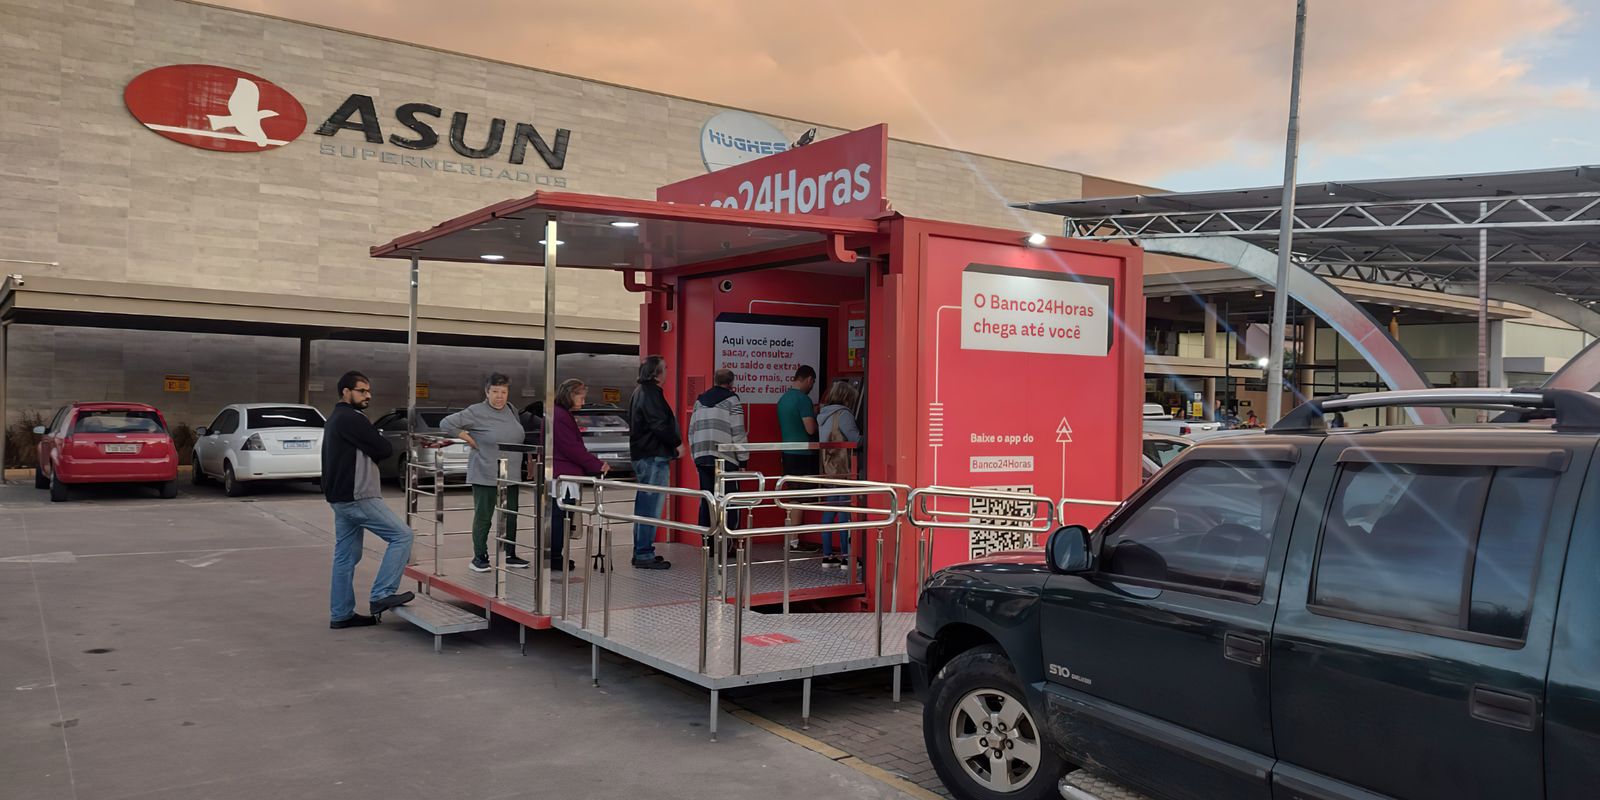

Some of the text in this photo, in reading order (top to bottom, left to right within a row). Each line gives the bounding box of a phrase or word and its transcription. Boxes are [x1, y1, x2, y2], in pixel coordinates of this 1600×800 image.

[314, 93, 571, 171] ASUN
[708, 128, 787, 155] HUGHES
[319, 143, 568, 188] SUPERMERCADOS
[973, 293, 1094, 317] O Banco24Horas
[973, 318, 1081, 339] chega até você
[722, 335, 794, 348] Aqui você pode:
[722, 349, 794, 359] sacar, consultar
[740, 360, 764, 369] saldo
[759, 373, 783, 382] mais,
[970, 433, 1034, 445] Baixe o app do
[972, 459, 1032, 470] Banco24Horas
[1049, 663, 1071, 678] S10
